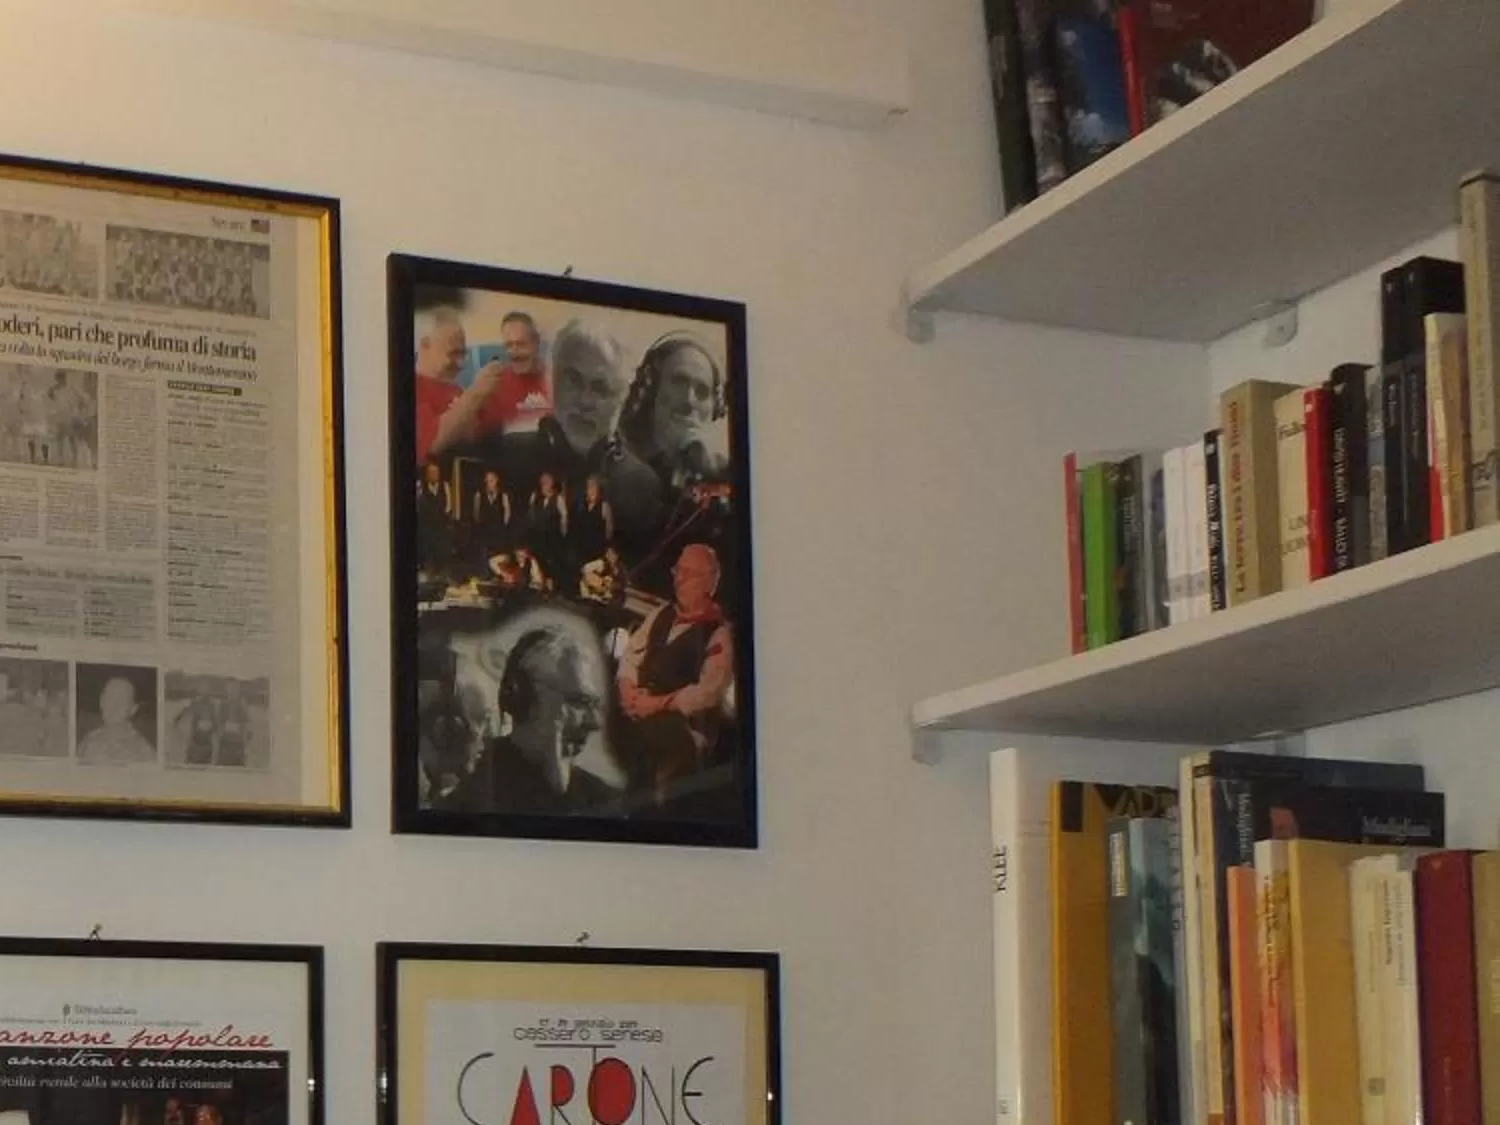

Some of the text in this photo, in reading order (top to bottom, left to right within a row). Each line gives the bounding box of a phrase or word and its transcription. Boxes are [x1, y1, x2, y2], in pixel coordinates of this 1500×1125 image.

[48, 319, 82, 345] pari
[85, 322, 115, 346] che
[117, 328, 190, 353] profuma
[192, 335, 210, 356] di
[211, 340, 257, 363] storia
[992, 844, 1008, 893] KLEE
[127, 1023, 274, 1054] popolare
